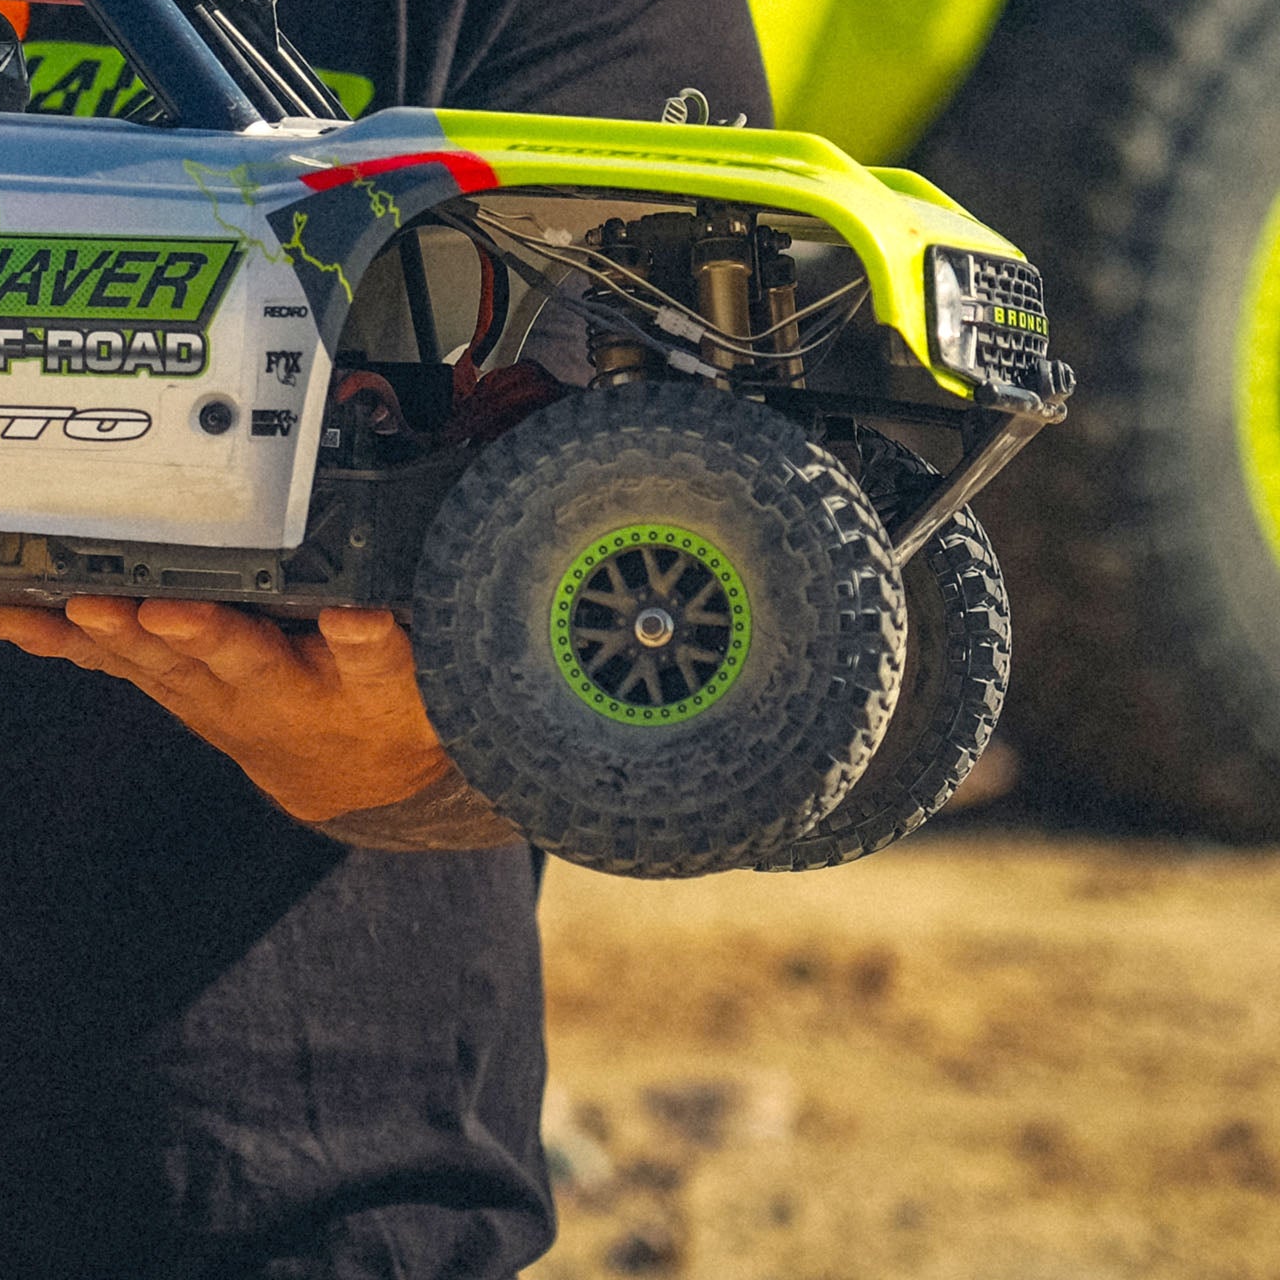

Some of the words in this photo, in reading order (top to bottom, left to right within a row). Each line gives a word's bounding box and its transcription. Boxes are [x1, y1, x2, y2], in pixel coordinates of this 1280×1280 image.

[264, 305, 309, 318] RECARO
[994, 306, 1047, 336] BRONCO
[265, 350, 302, 380] FOX
